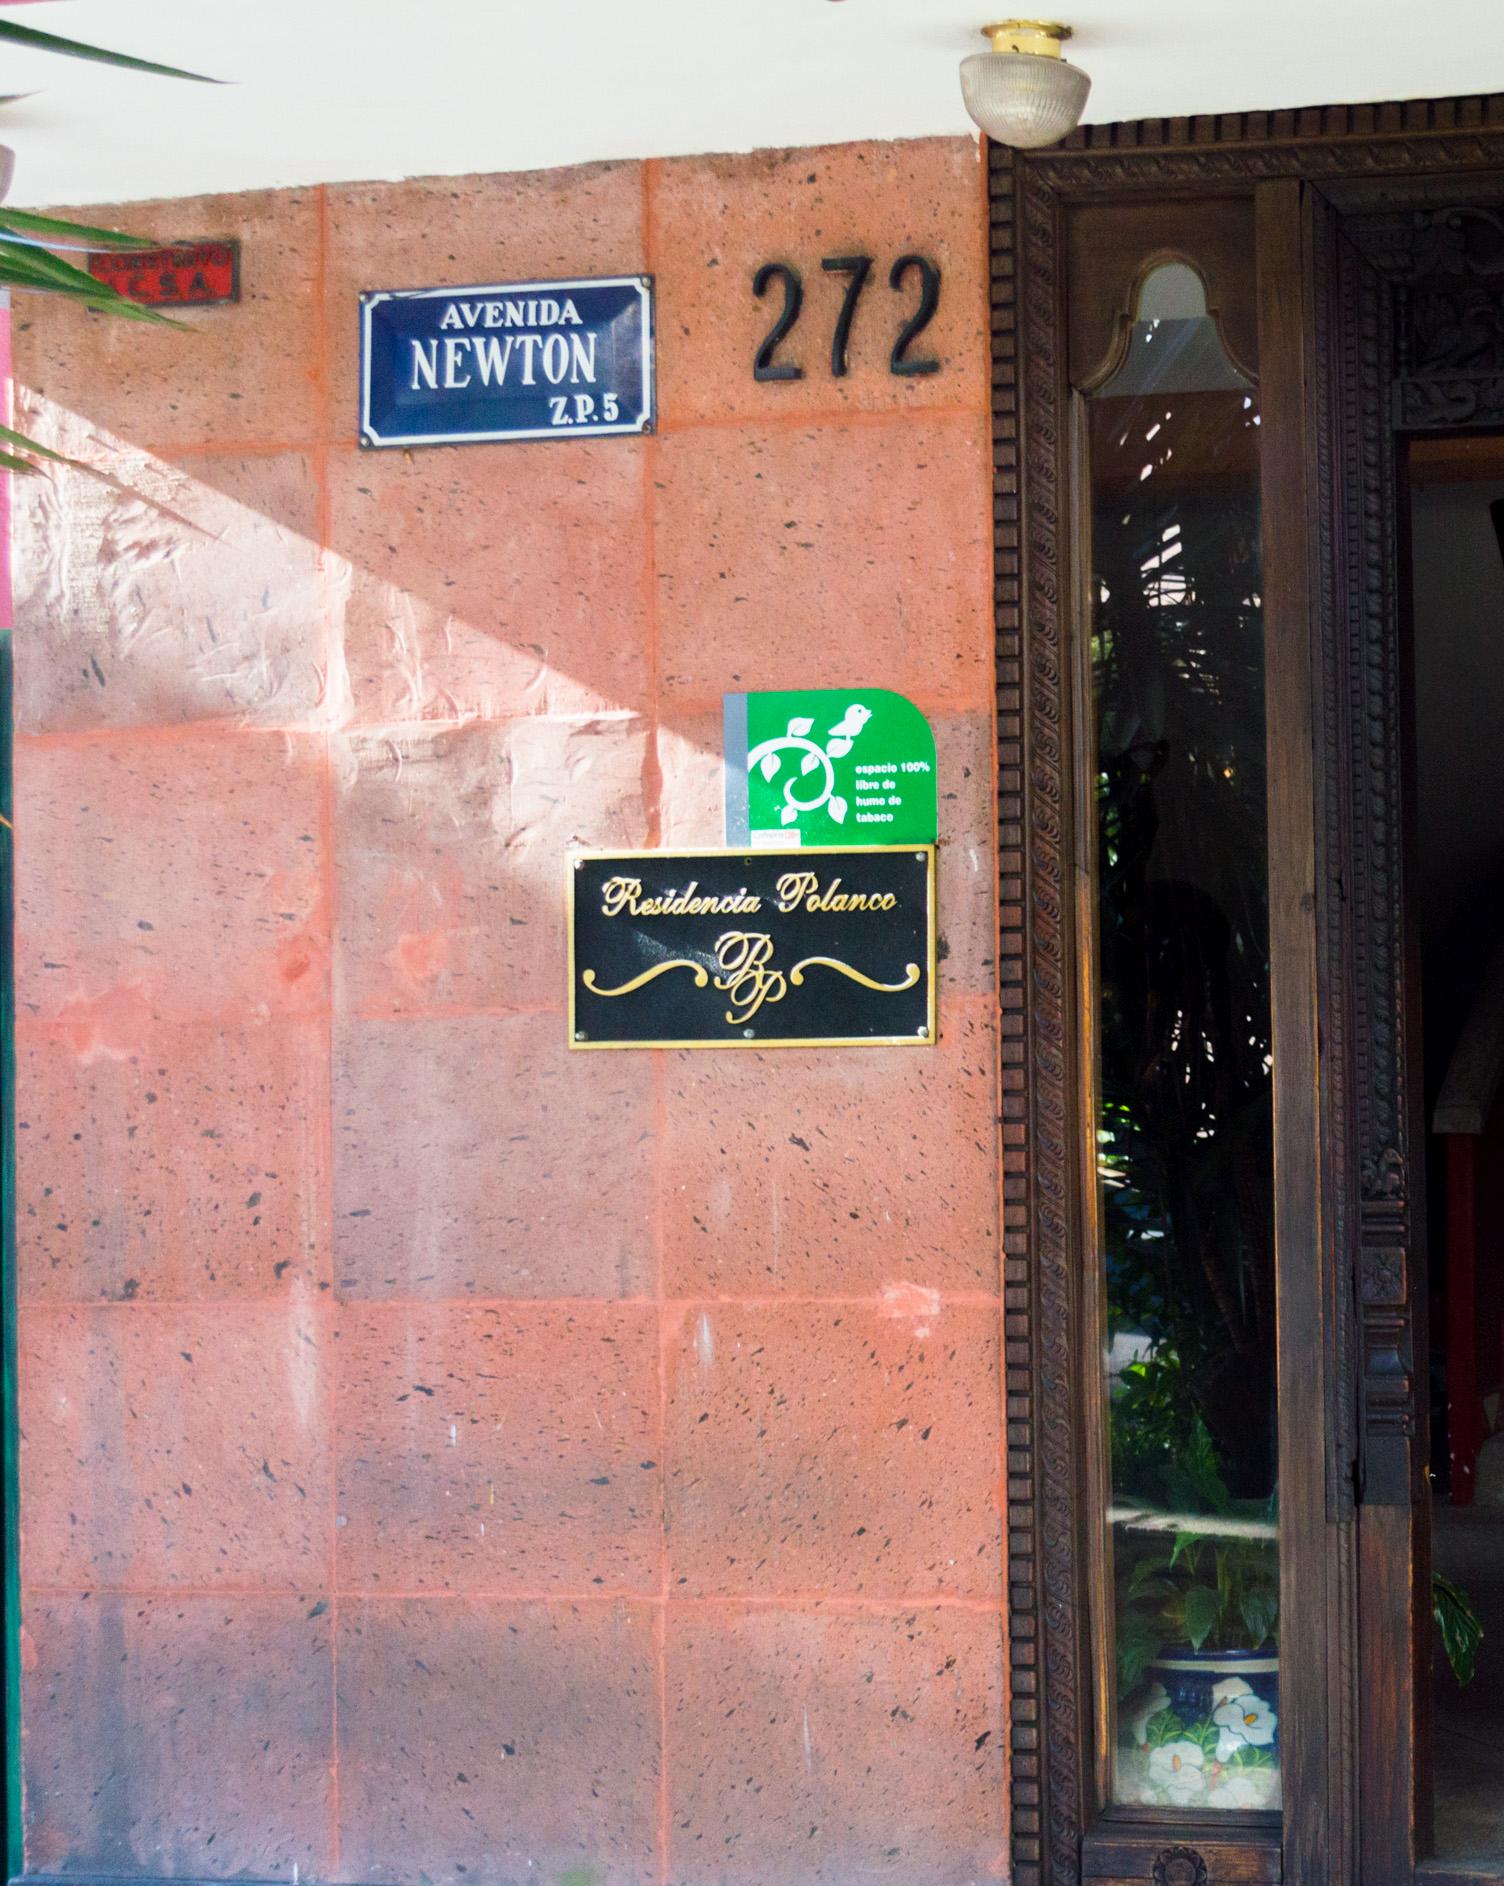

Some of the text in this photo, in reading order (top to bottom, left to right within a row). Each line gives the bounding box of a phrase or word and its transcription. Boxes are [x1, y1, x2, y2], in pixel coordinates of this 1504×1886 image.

[440, 299, 583, 330] AVENIDA
[753, 255, 942, 382] 272
[411, 332, 597, 390] NEWTON
[855, 761, 931, 776] espacio 100%
[855, 779, 896, 791] libre de
[855, 795, 902, 807] humo de
[856, 812, 894, 823] tabaco
[601, 871, 898, 917] Residencia Polanco
